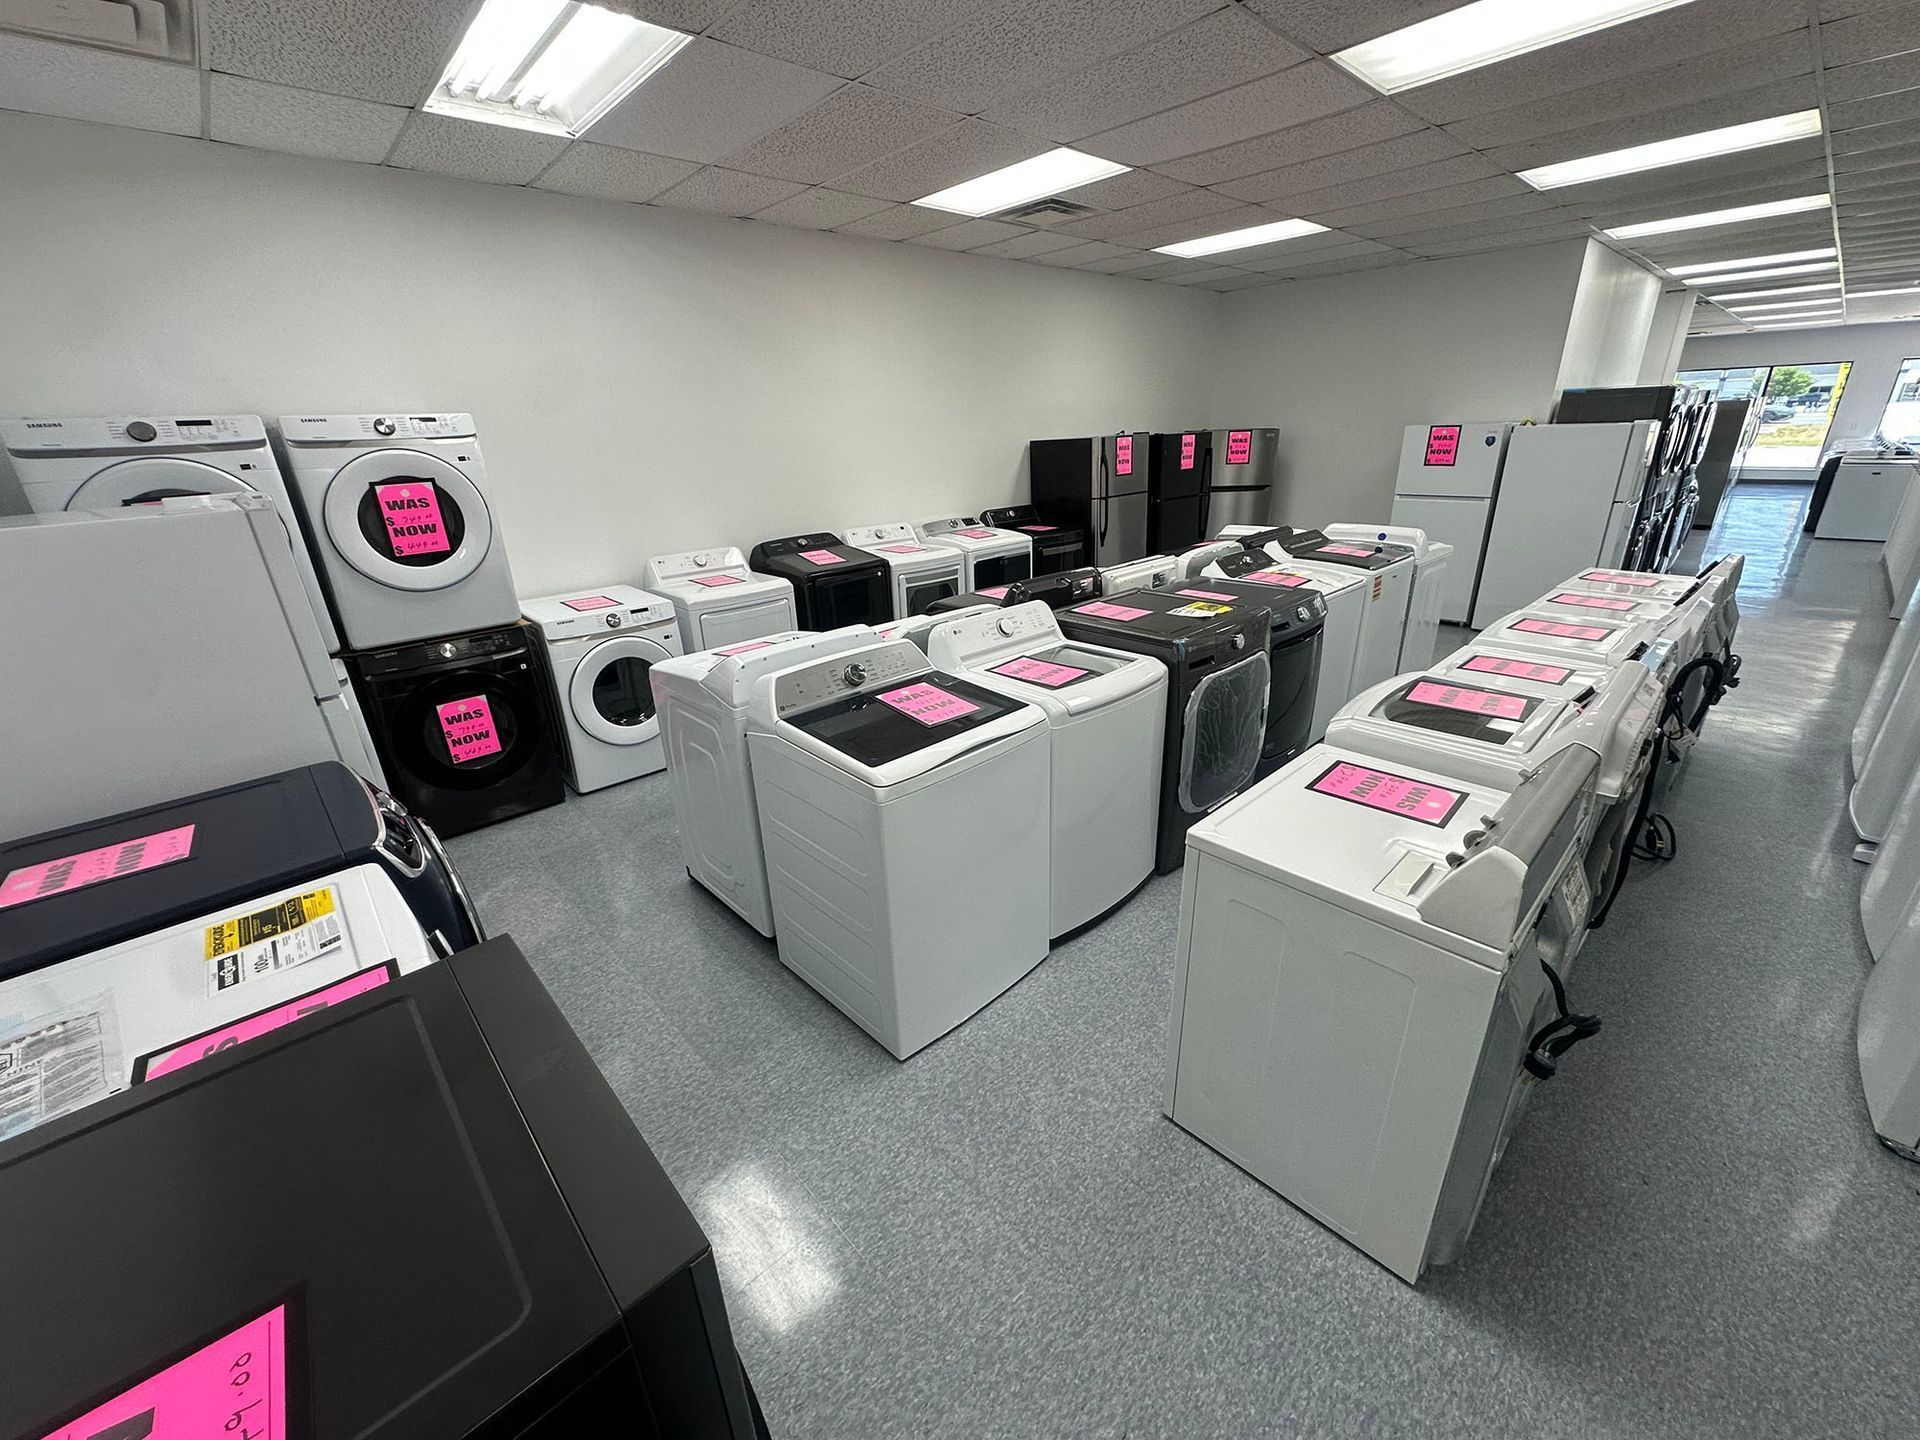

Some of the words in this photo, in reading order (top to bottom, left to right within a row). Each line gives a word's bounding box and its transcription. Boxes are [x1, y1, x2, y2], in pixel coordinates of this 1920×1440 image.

[385, 498, 430, 511] WAS
[385, 516, 396, 527] $
[392, 523, 437, 538] NOW
[394, 545, 404, 555] $
[890, 689, 935, 704] WAS
[911, 699, 956, 715] NOW
[444, 709, 484, 725] WAS
[445, 730, 454, 739] $
[450, 730, 490, 747] NOW
[453, 753, 461, 761] $
[1350, 774, 1386, 798] NOW
[1396, 787, 1432, 811] WAS
[113, 842, 147, 874] NOW
[37, 860, 77, 895] WAS
